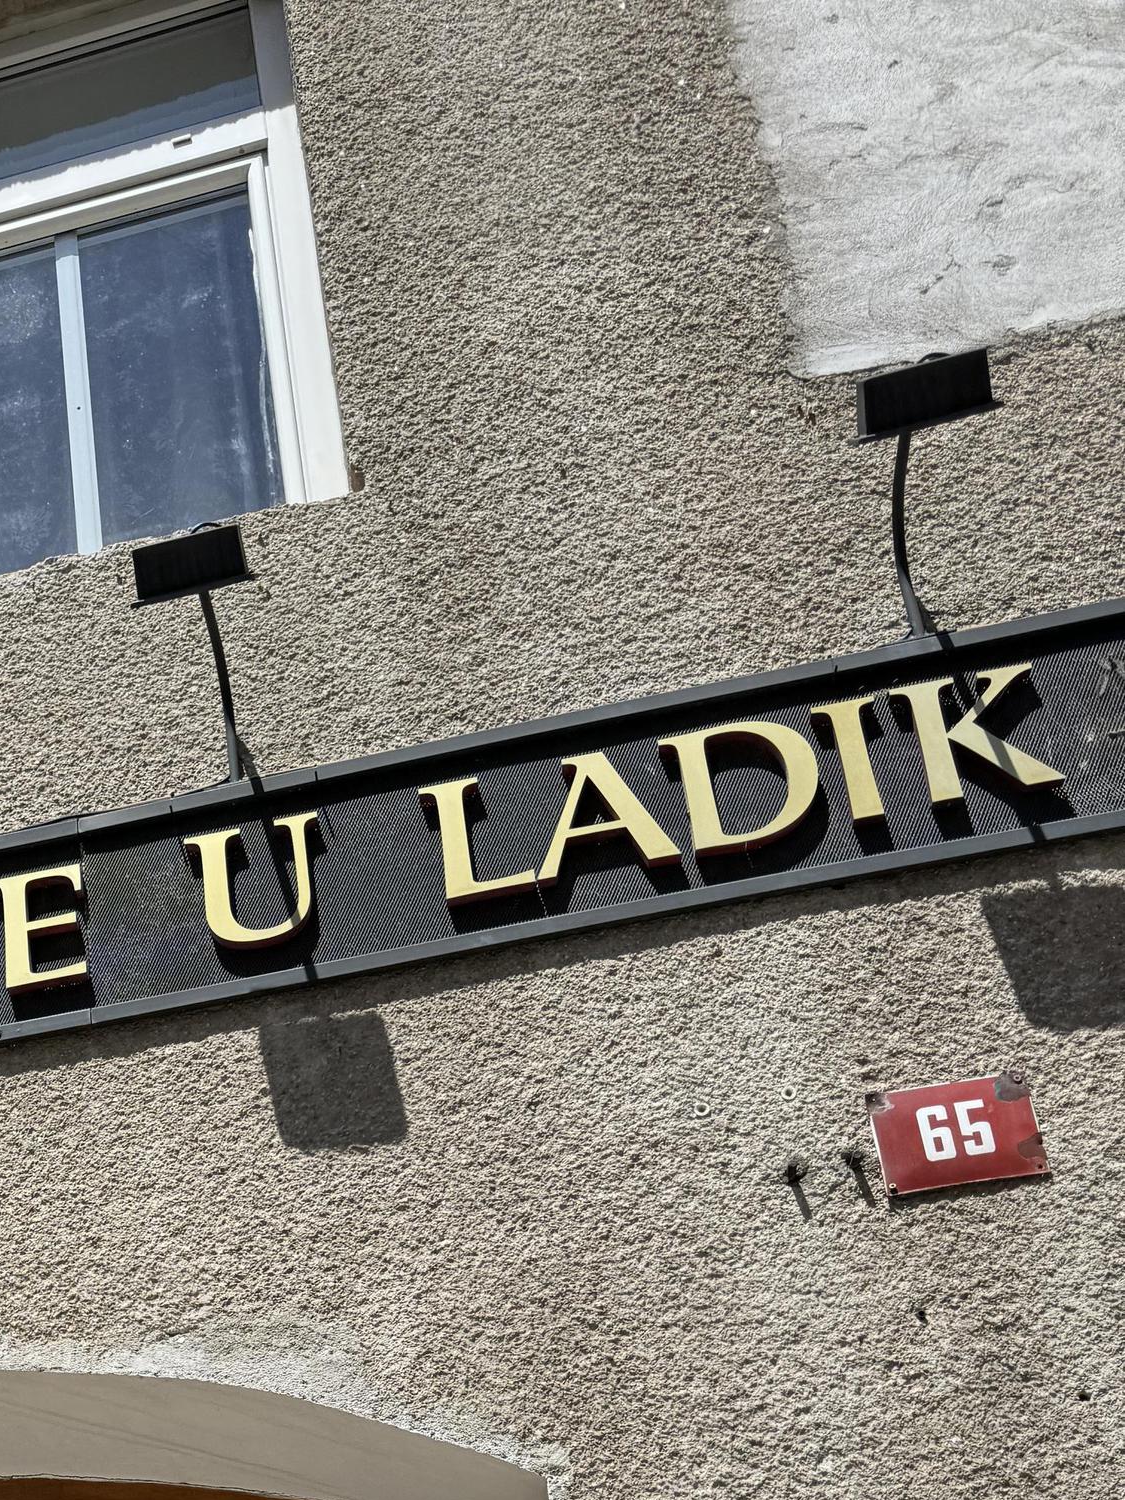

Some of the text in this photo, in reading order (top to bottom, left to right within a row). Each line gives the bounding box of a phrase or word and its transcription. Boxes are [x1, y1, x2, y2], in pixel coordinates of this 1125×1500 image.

[183, 811, 318, 950] U
[418, 662, 1066, 906] LADIK
[915, 1099, 996, 1162] 65
